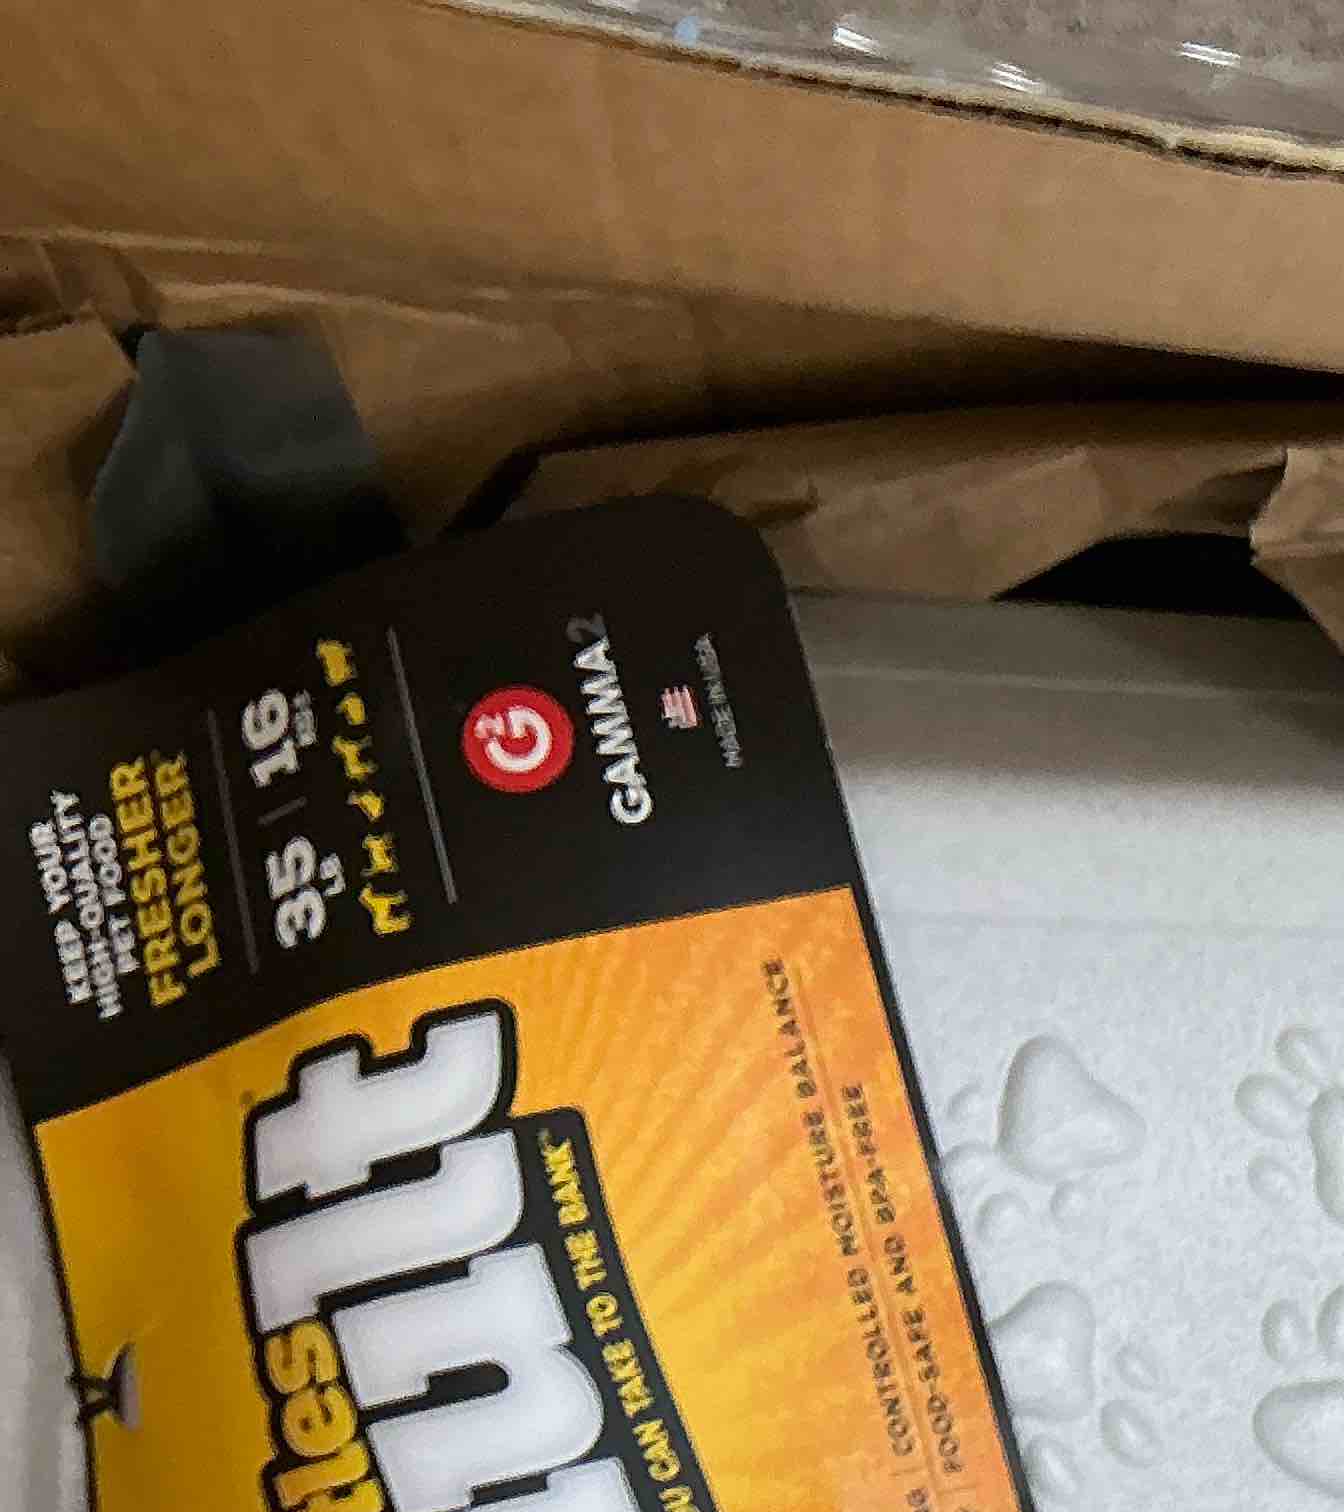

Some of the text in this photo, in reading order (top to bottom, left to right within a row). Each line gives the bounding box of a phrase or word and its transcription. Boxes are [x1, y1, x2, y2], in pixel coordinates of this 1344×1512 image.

[89, 813, 140, 976] PET FOOD
[110, 757, 187, 1007] FRESHER
[155, 752, 221, 978] LONGER
[241, 688, 327, 950] 35 16
[29, 821, 94, 1004] KEEP YOUR
[564, 1229, 607, 1290] THE
[761, 959, 914, 1457] CONTROLLED MOISTURE BALANCE
[841, 1082, 964, 1473] FOOD-SAFE AND BPA-FREE
[585, 1291, 624, 1338] TO
[602, 1339, 654, 1418] TAKE
[632, 1418, 681, 1483] CAN
